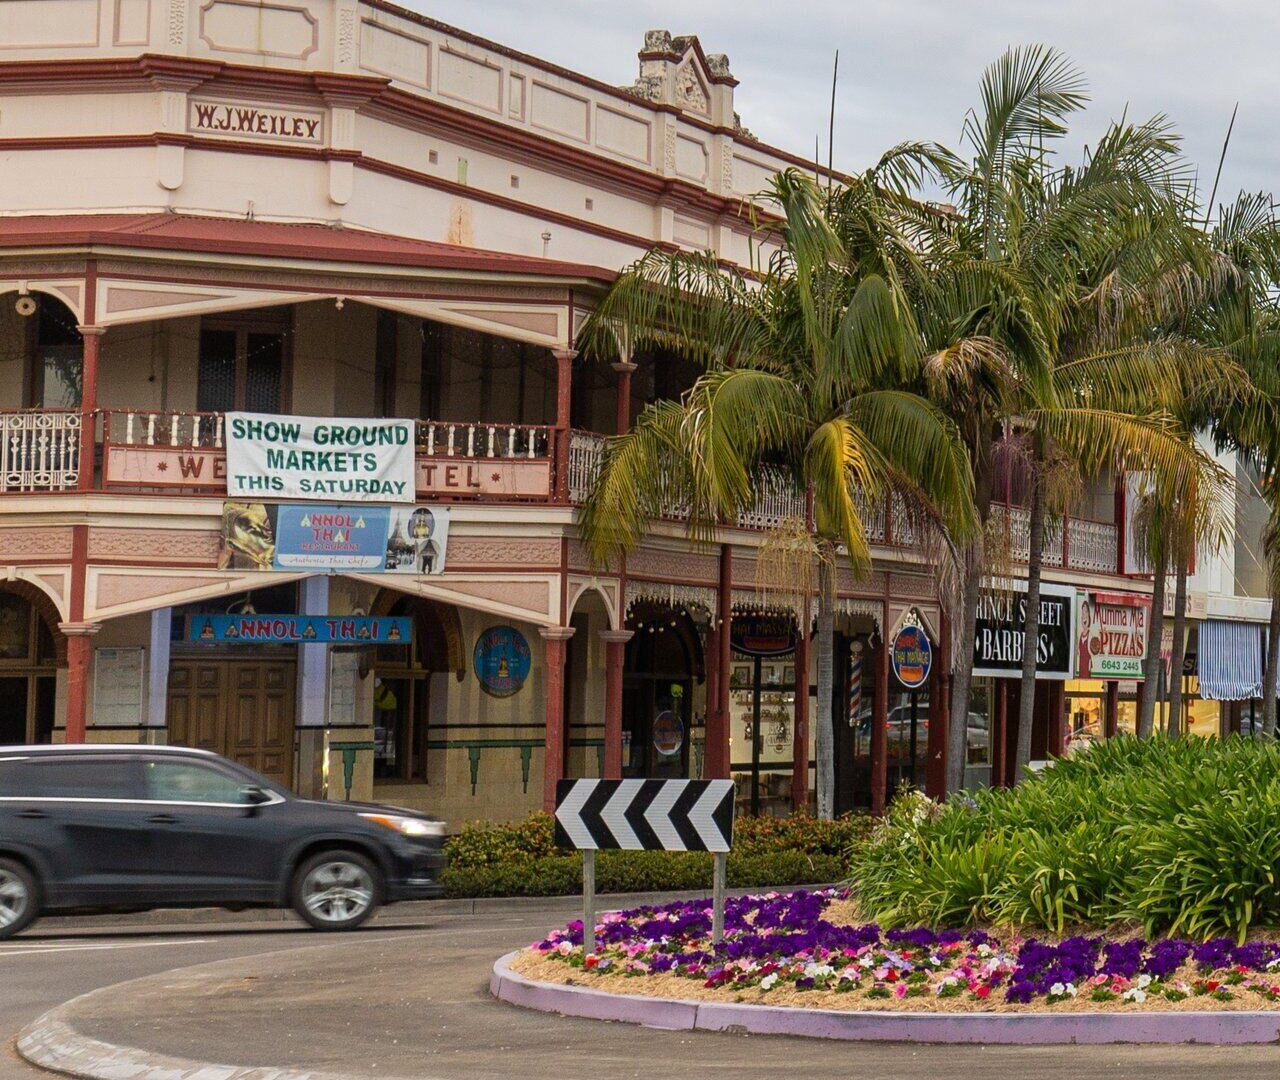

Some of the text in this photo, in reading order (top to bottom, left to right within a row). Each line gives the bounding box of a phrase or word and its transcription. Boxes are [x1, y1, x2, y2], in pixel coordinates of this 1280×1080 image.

[232, 419, 409, 447] SHOW GROUND
[266, 449, 378, 472] MARKETS
[235, 475, 406, 496] THIS SATURDAY
[421, 464, 482, 488] TEL
[313, 528, 350, 542] THAI
[326, 619, 378, 640] THAI
[1100, 632, 1144, 658] PIZZAS
[1101, 660, 1139, 671] 6643 2445
